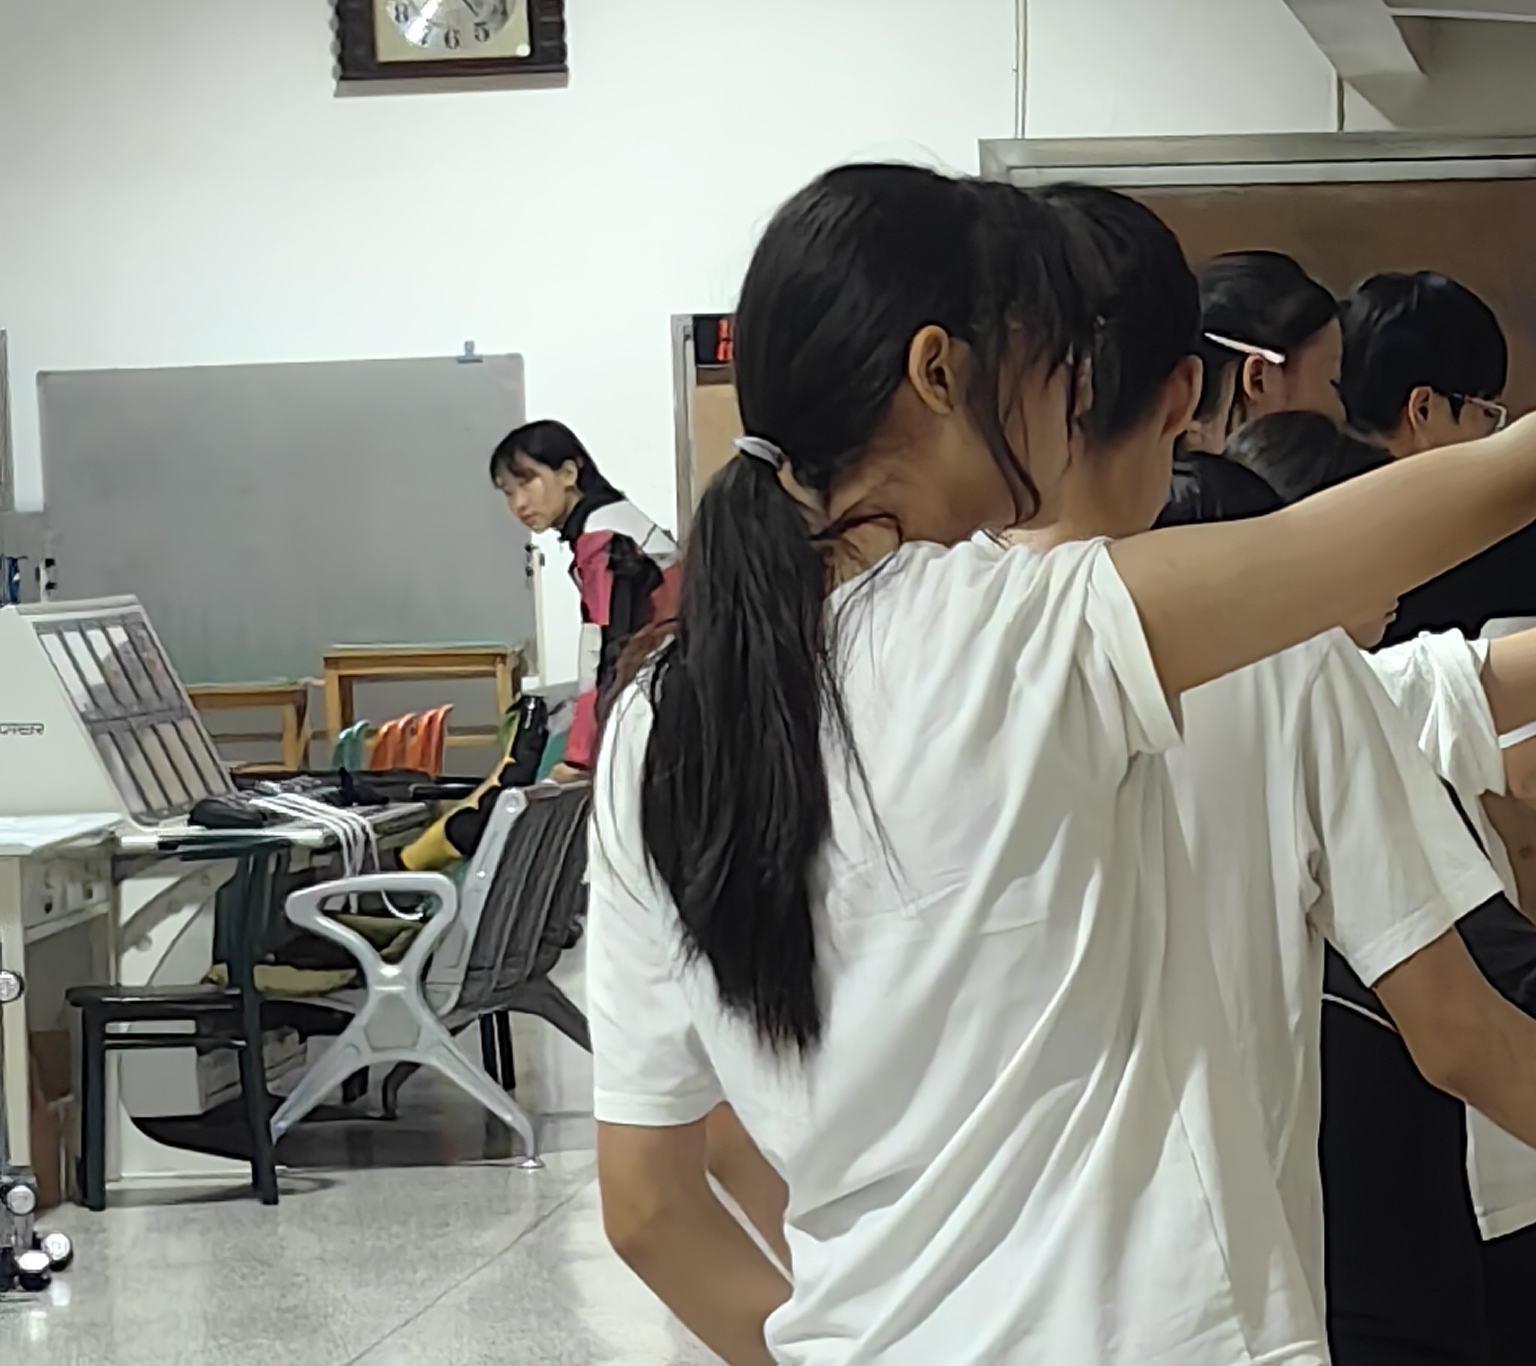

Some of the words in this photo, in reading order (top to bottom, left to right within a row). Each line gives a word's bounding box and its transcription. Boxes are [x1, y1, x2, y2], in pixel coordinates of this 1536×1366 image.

[394, 3, 409, 24] 8
[444, 29, 460, 50] 6
[474, 21, 490, 43] 5
